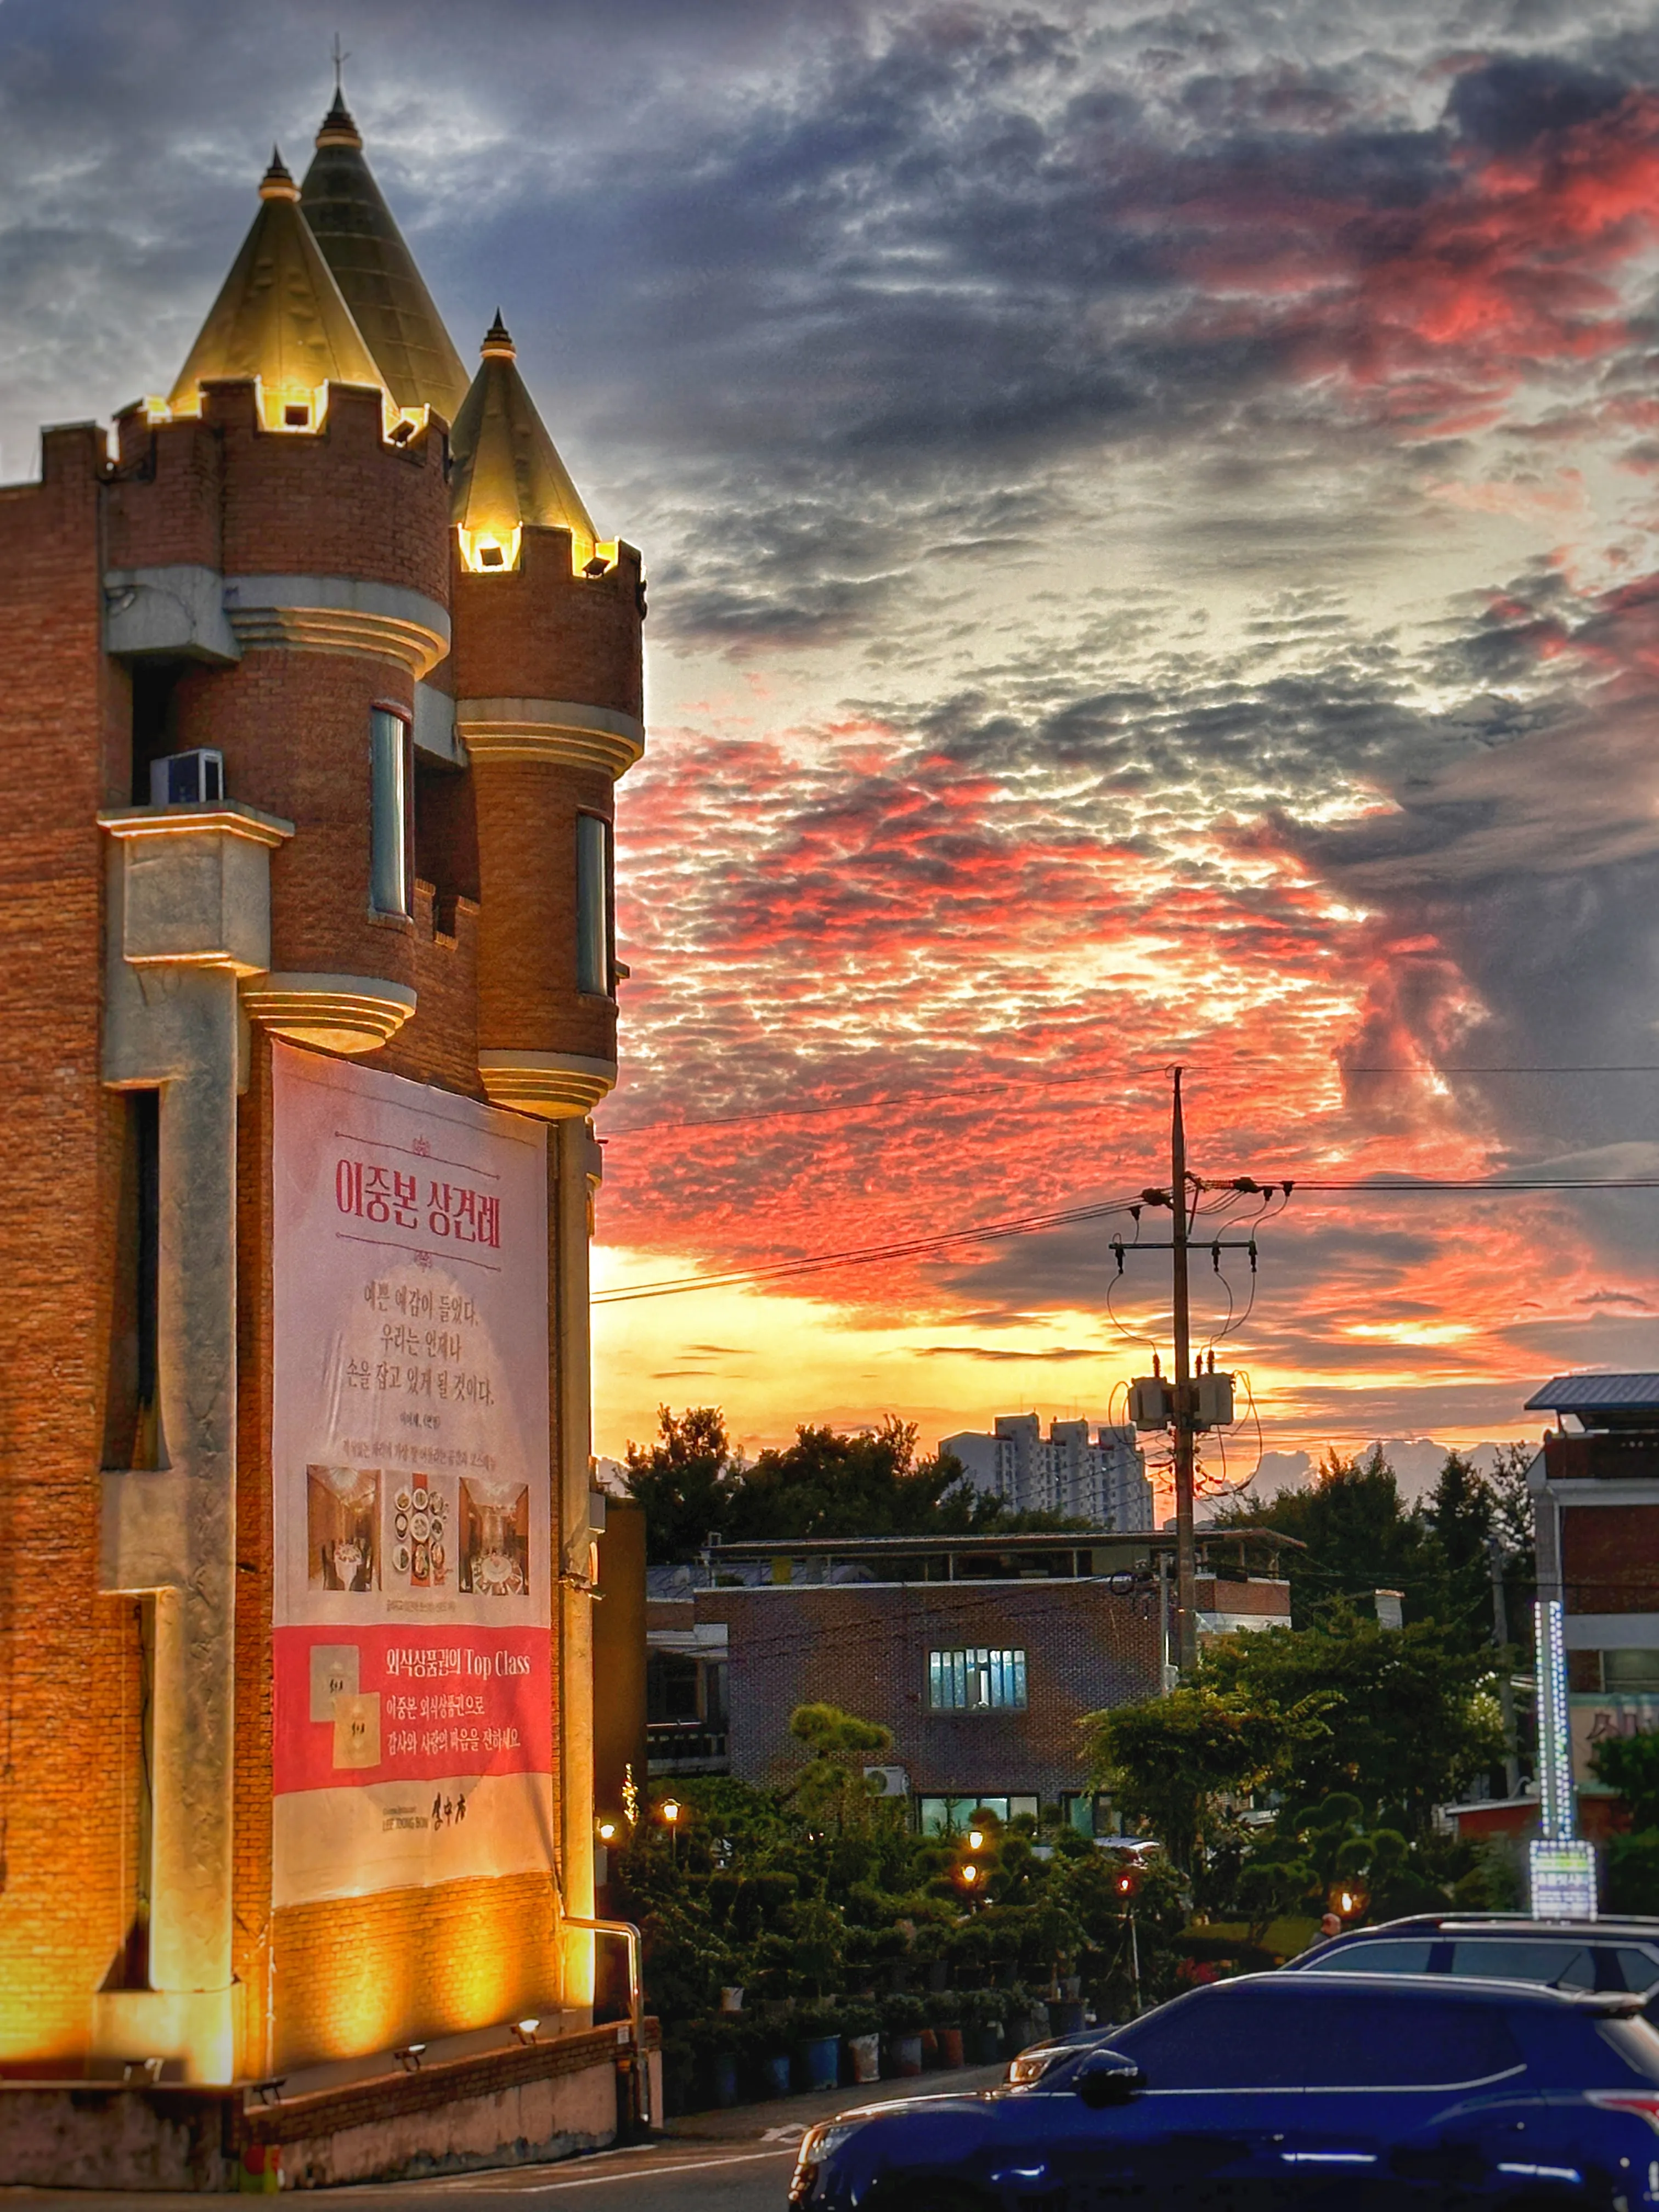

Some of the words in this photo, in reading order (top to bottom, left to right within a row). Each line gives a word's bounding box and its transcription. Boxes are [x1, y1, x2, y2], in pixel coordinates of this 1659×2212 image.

[336, 1159, 417, 1229] 이중본
[427, 1181, 500, 1248] 상견례
[364, 1280, 390, 1311] 예쁜
[395, 1285, 433, 1320] 예감이
[439, 1296, 478, 1327] 들었다.
[380, 1323, 419, 1357] 우리는
[425, 1329, 461, 1363] 언제나
[346, 1358, 371, 1390] 손을
[376, 1361, 402, 1391] 잡고
[407, 1367, 432, 1397] 있게
[438, 1370, 448, 1400] 될
[454, 1373, 494, 1406] 것이다.
[386, 1648, 461, 1678] 외식상품권의
[465, 1649, 492, 1680] Top
[495, 1650, 531, 1677] Class
[387, 1695, 417, 1720] 이중본
[420, 1694, 485, 1721] 외식상품권으로
[387, 1730, 417, 1756] 감사와
[421, 1729, 448, 1756] 사랑의
[450, 1727, 479, 1752] 마음을
[483, 1727, 521, 1752] 전하세요
